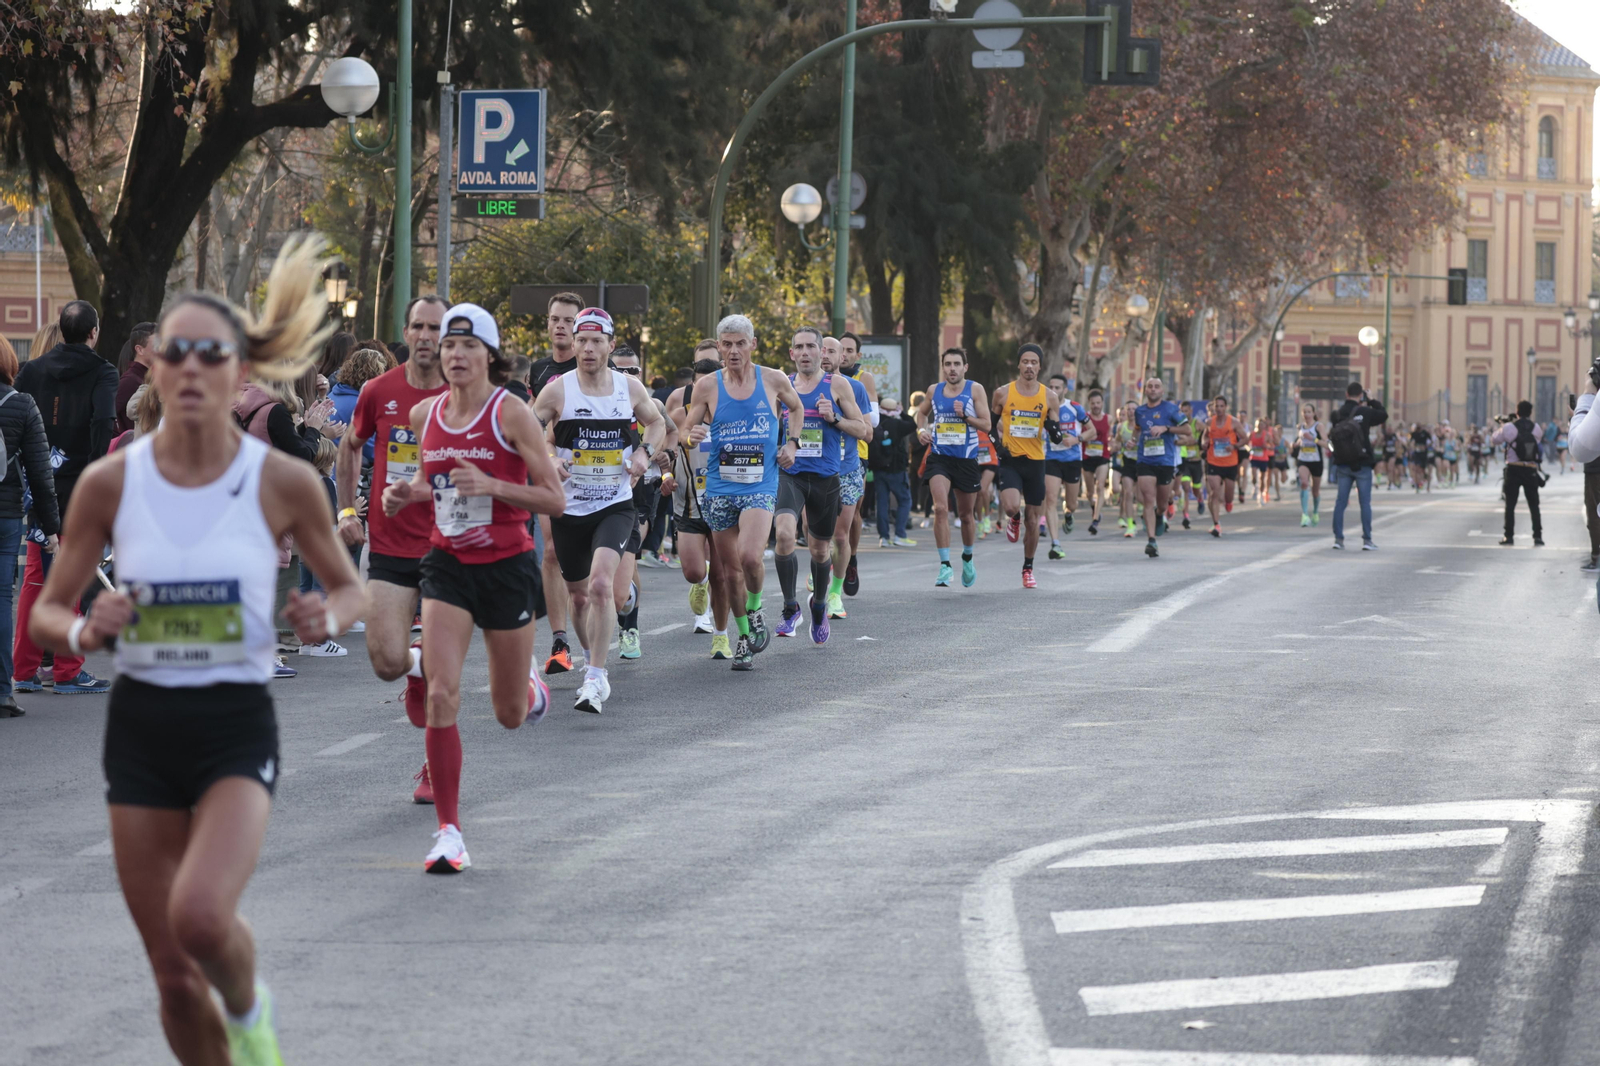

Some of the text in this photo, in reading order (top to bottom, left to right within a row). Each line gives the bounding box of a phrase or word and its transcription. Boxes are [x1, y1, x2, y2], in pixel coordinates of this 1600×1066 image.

[473, 98, 515, 163] P
[460, 171, 537, 185] AVDA. ROMA
[477, 200, 517, 215] LIBRE
[578, 427, 621, 439] kiwami
[719, 426, 747, 436] SEVILLA
[589, 441, 619, 449] ZURICH
[591, 456, 606, 464] 785
[733, 457, 750, 465] 2577
[156, 584, 229, 601] ZURICH
[154, 648, 211, 662] IRELAND
